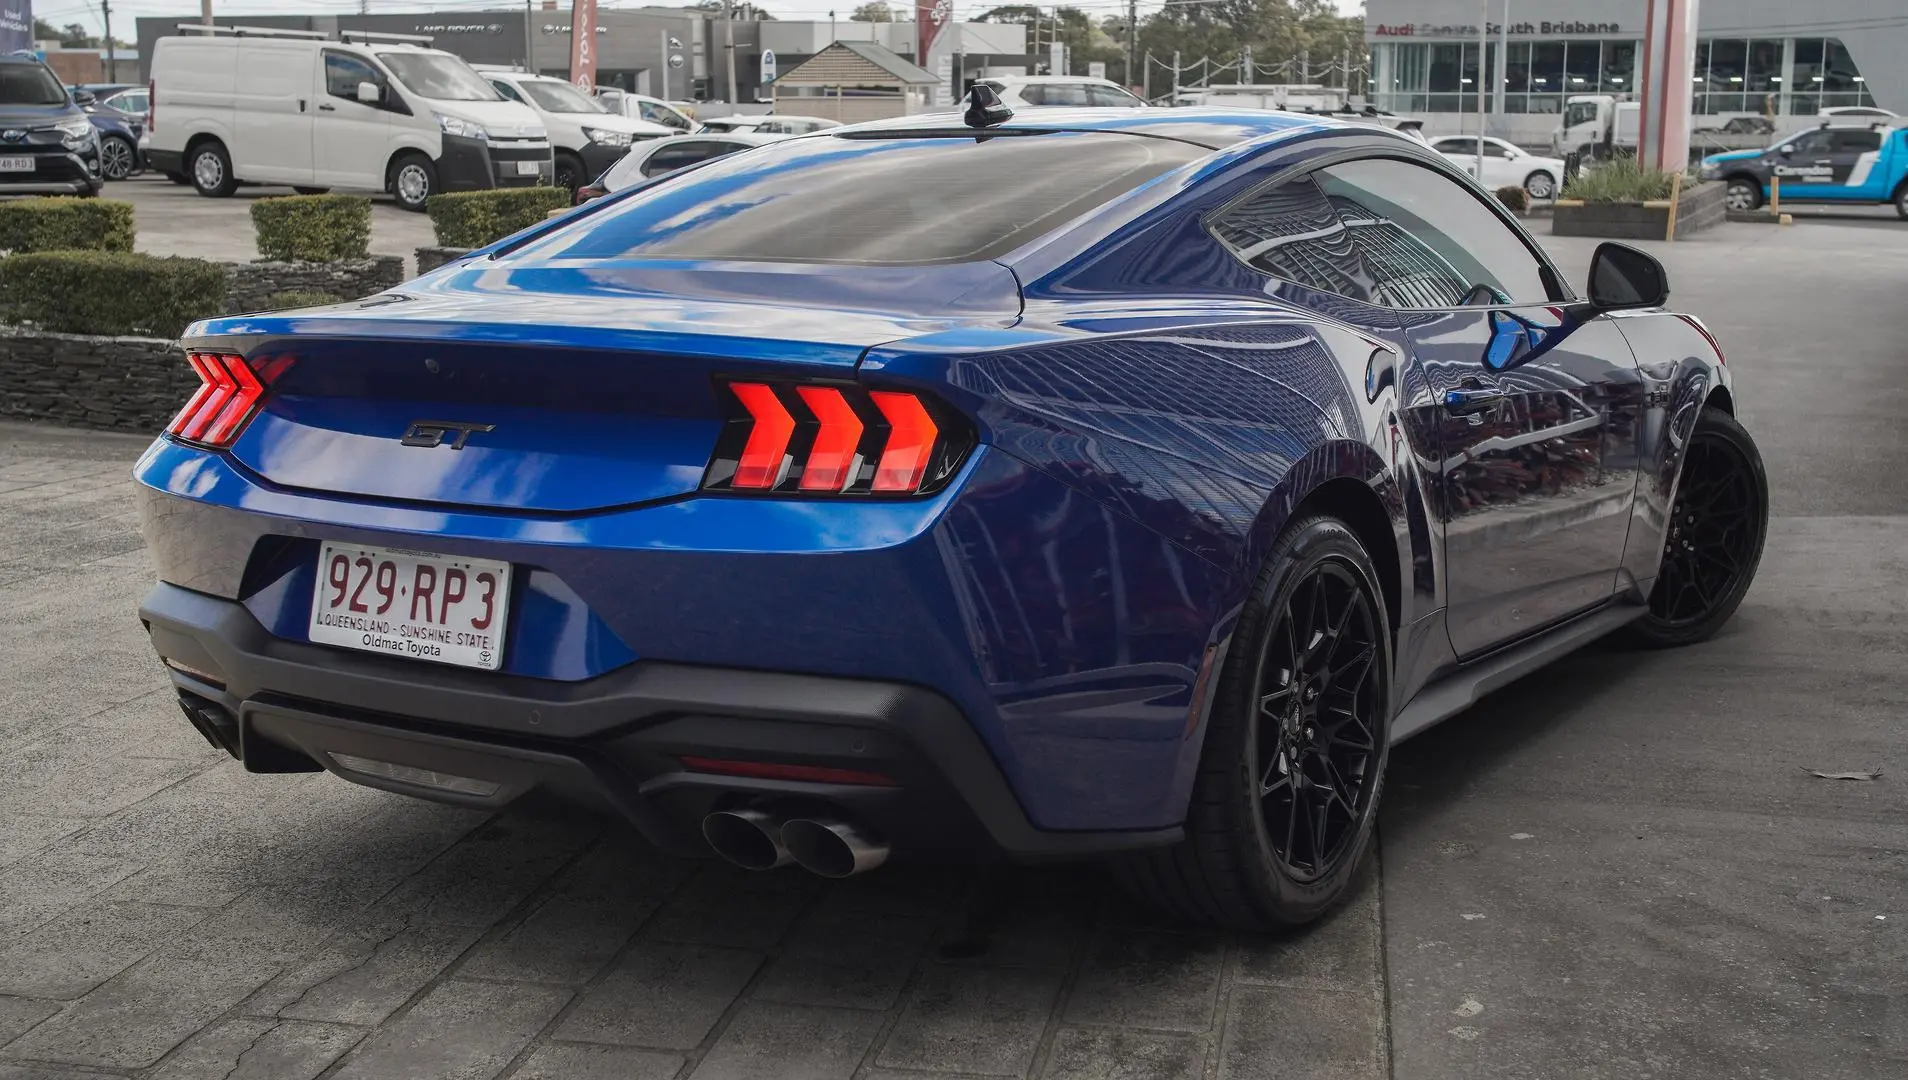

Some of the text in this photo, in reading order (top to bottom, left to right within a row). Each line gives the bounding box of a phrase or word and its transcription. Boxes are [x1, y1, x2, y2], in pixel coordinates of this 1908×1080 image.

[1376, 23, 1414, 36] Audi
[1485, 23, 1534, 35] South
[1540, 21, 1620, 34] Brisbane
[400, 419, 496, 451] GT
[324, 614, 390, 634] QUEENSLAND
[400, 625, 451, 645] SUNSHINE
[457, 633, 489, 650] STATE
[363, 633, 441, 657] Oldmac Toyota
